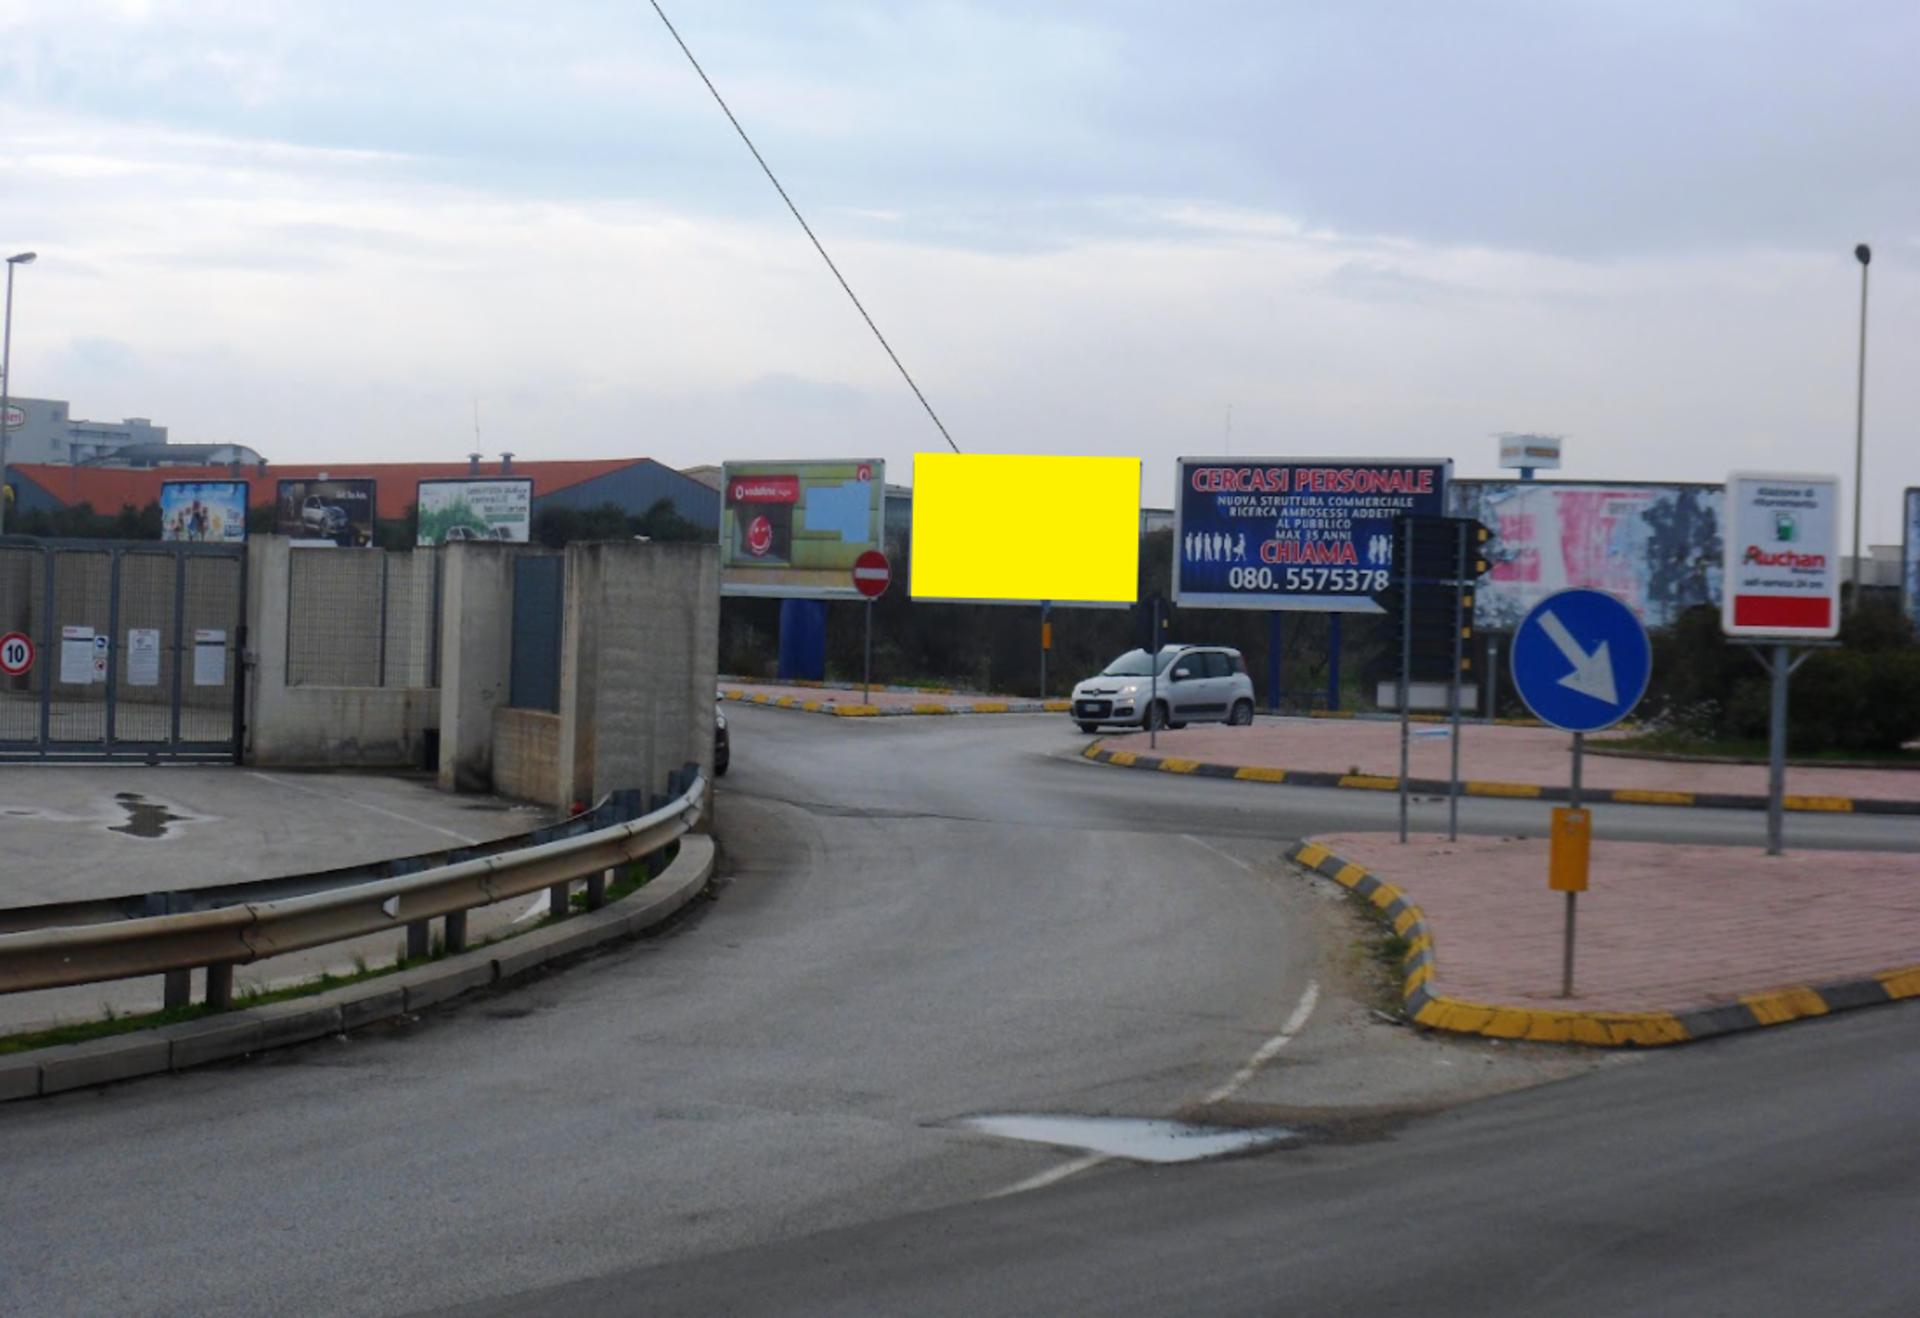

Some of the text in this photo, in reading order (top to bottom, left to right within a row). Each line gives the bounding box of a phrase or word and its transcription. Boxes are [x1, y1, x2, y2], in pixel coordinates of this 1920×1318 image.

[1192, 467, 1434, 494] CERCASI PERSONALE
[1217, 496, 1414, 508] NUOVA STRUTTURA COMMERCIALE
[1229, 506, 1277, 518] RICERCA
[1280, 507, 1348, 518] AMBOSESSI
[1275, 518, 1353, 529] AL PUBBLICO
[1275, 530, 1300, 540] MAX
[1322, 530, 1352, 541] ANNI
[1260, 539, 1359, 565] CHIAMA
[1743, 545, 1826, 568] Auchan
[1229, 566, 1389, 591] 080. 5575378
[7, 644, 25, 664] 10
